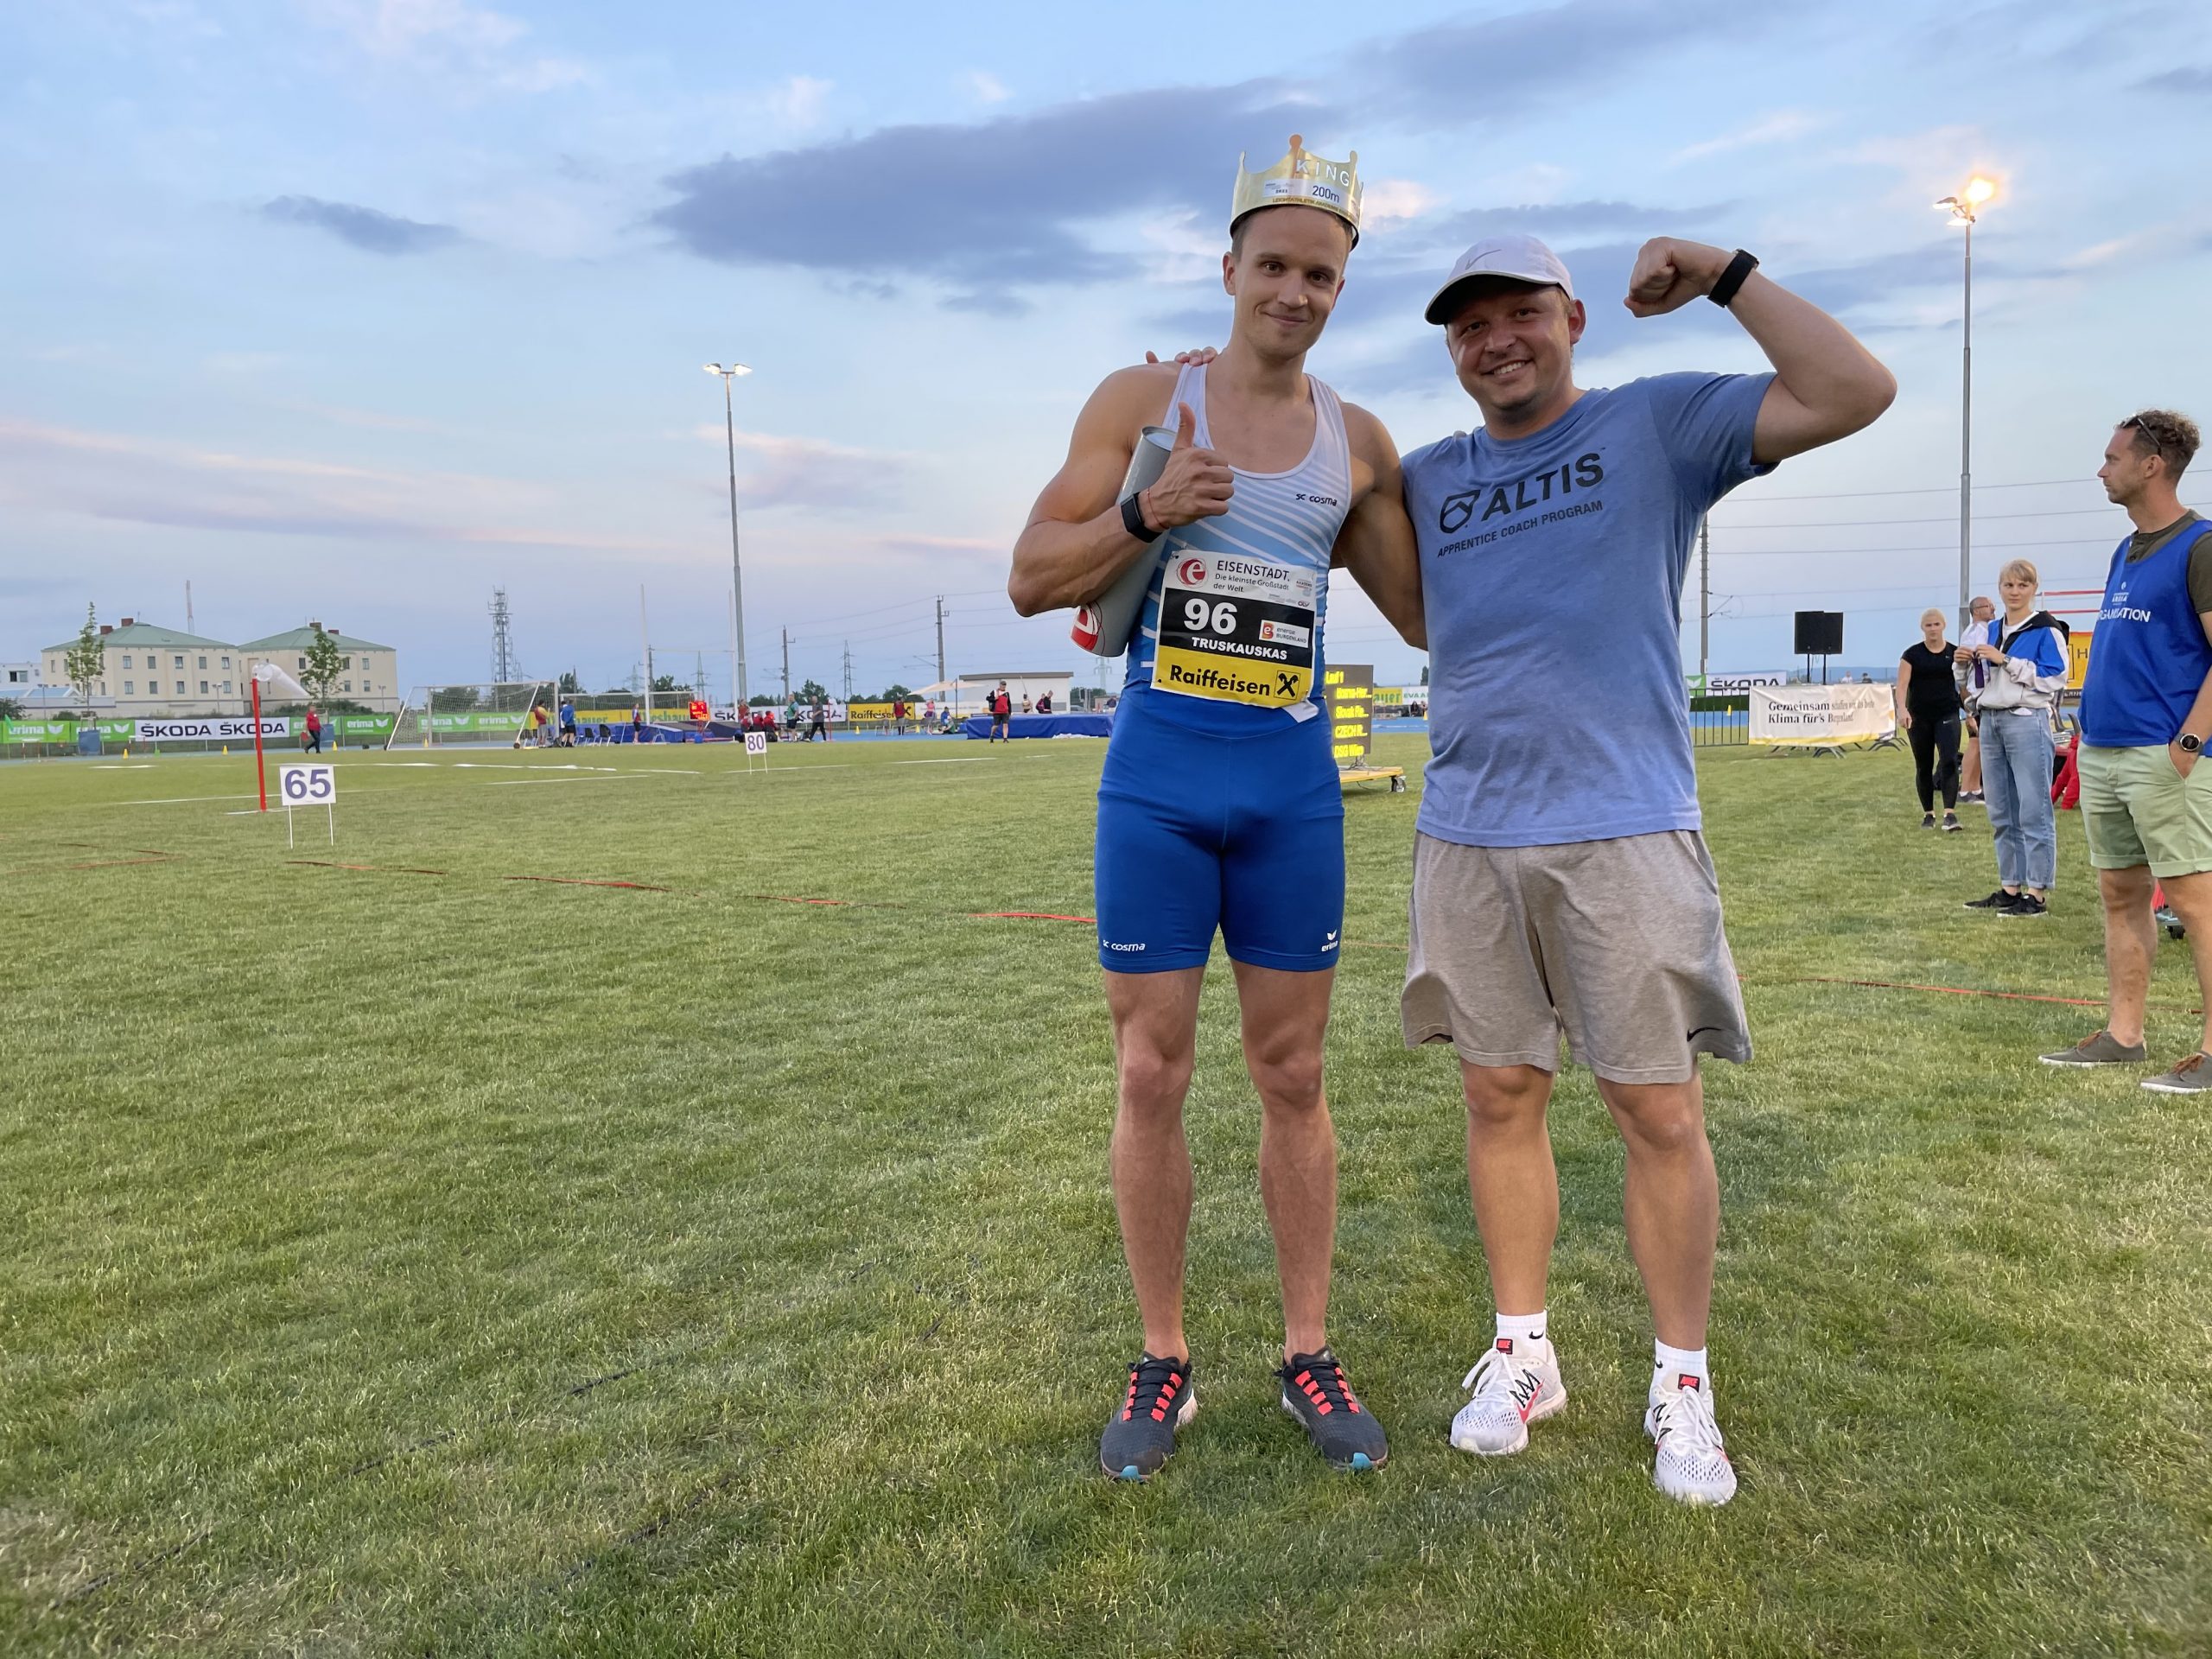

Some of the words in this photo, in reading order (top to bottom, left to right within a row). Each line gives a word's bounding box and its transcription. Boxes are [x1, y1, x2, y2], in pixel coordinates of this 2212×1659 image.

[1296, 159, 1350, 187] KING
[1313, 185, 1340, 203] 200m
[1480, 453, 1604, 522] ALTIS
[1309, 495, 1338, 506] cosma
[1437, 531, 1497, 557] APPRENTICE
[1501, 518, 1538, 537] COACH
[1541, 500, 1603, 524] PROGRAM
[1217, 560, 1291, 582] EISENSTADT.
[1213, 582, 1226, 591] der
[1228, 575, 1256, 586] kleinste
[1257, 579, 1289, 591] Großstadt
[1184, 598, 1237, 635] 96
[1192, 636, 1287, 660] TRUSKAUSKAS
[1170, 664, 1271, 696] Raiffeisen
[1769, 701, 1830, 711] Gemeinsam
[347, 719, 374, 728] erima
[1769, 713, 1800, 723] Klima
[1802, 713, 1825, 723] für's
[141, 723, 212, 737] ŠKODA
[747, 734, 765, 750] 80
[285, 769, 331, 798] 65
[1111, 943, 1146, 951] cosma
